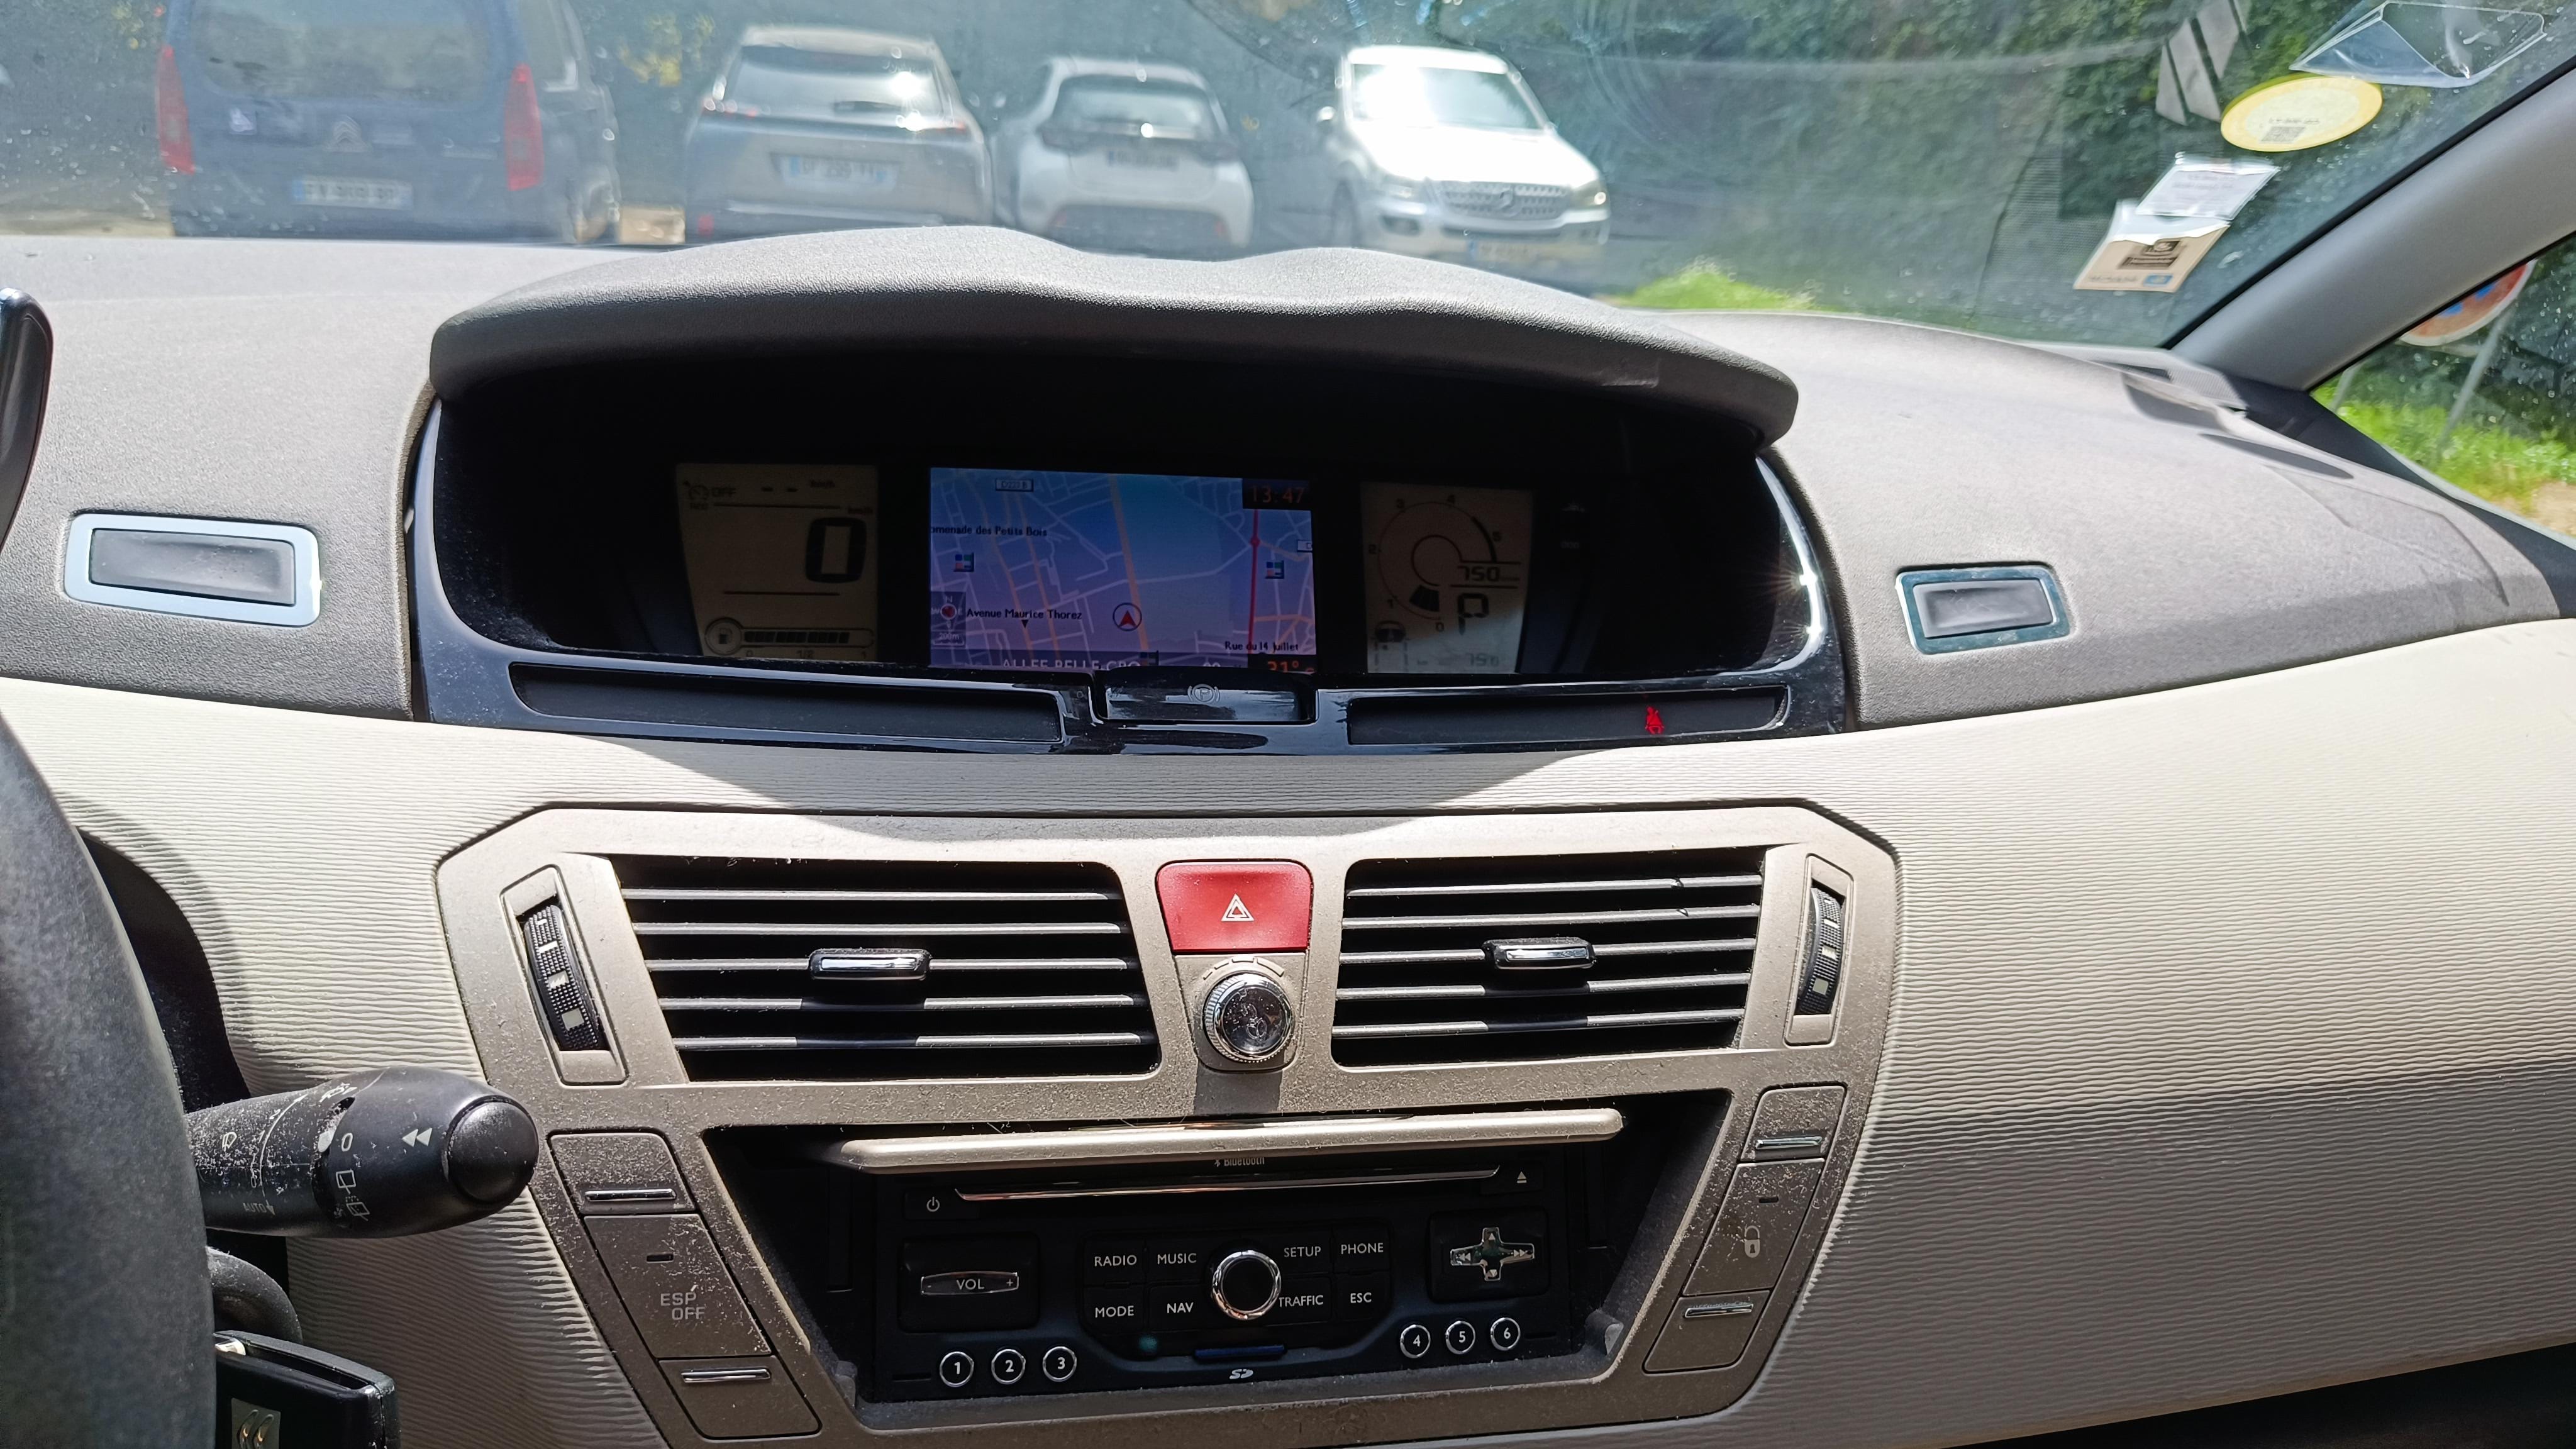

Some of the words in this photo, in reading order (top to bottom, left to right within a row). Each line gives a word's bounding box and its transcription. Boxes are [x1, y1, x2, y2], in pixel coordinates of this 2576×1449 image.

[1252, 486, 1306, 504] 13:47
[976, 525, 992, 535] des
[995, 526, 1023, 535] Petits
[1026, 526, 1047, 536] Bois
[805, 517, 867, 584] 0
[967, 609, 1001, 618] Avenue
[1005, 609, 1044, 618] Maurice
[1047, 609, 1082, 619] Thorez
[1457, 593, 1489, 636] P
[1225, 641, 1243, 650] Rue
[1246, 641, 1257, 650] du
[1260, 642, 1268, 650] 14
[1273, 642, 1299, 653] Juillet
[243, 1202, 268, 1214] AUTO
[1283, 1246, 1321, 1258] SETUP
[1341, 1242, 1384, 1255] PHONE
[1094, 1255, 1137, 1267] RADIO
[1157, 1253, 1197, 1265] MUSIC
[956, 1278, 985, 1290] VOL
[660, 1292, 697, 1306] ESP
[1279, 1294, 1324, 1307] TRAFFIC
[1350, 1292, 1372, 1304] ESC
[672, 1306, 706, 1320] OFF
[1095, 1305, 1135, 1318] MODE
[1167, 1302, 1194, 1314] NAV
[1458, 1331, 1466, 1343] 5
[1503, 1327, 1511, 1340] 6
[1413, 1335, 1421, 1347] 4
[953, 1362, 961, 1375] 1
[1005, 1359, 1014, 1373] 2
[1057, 1357, 1065, 1370] 3
